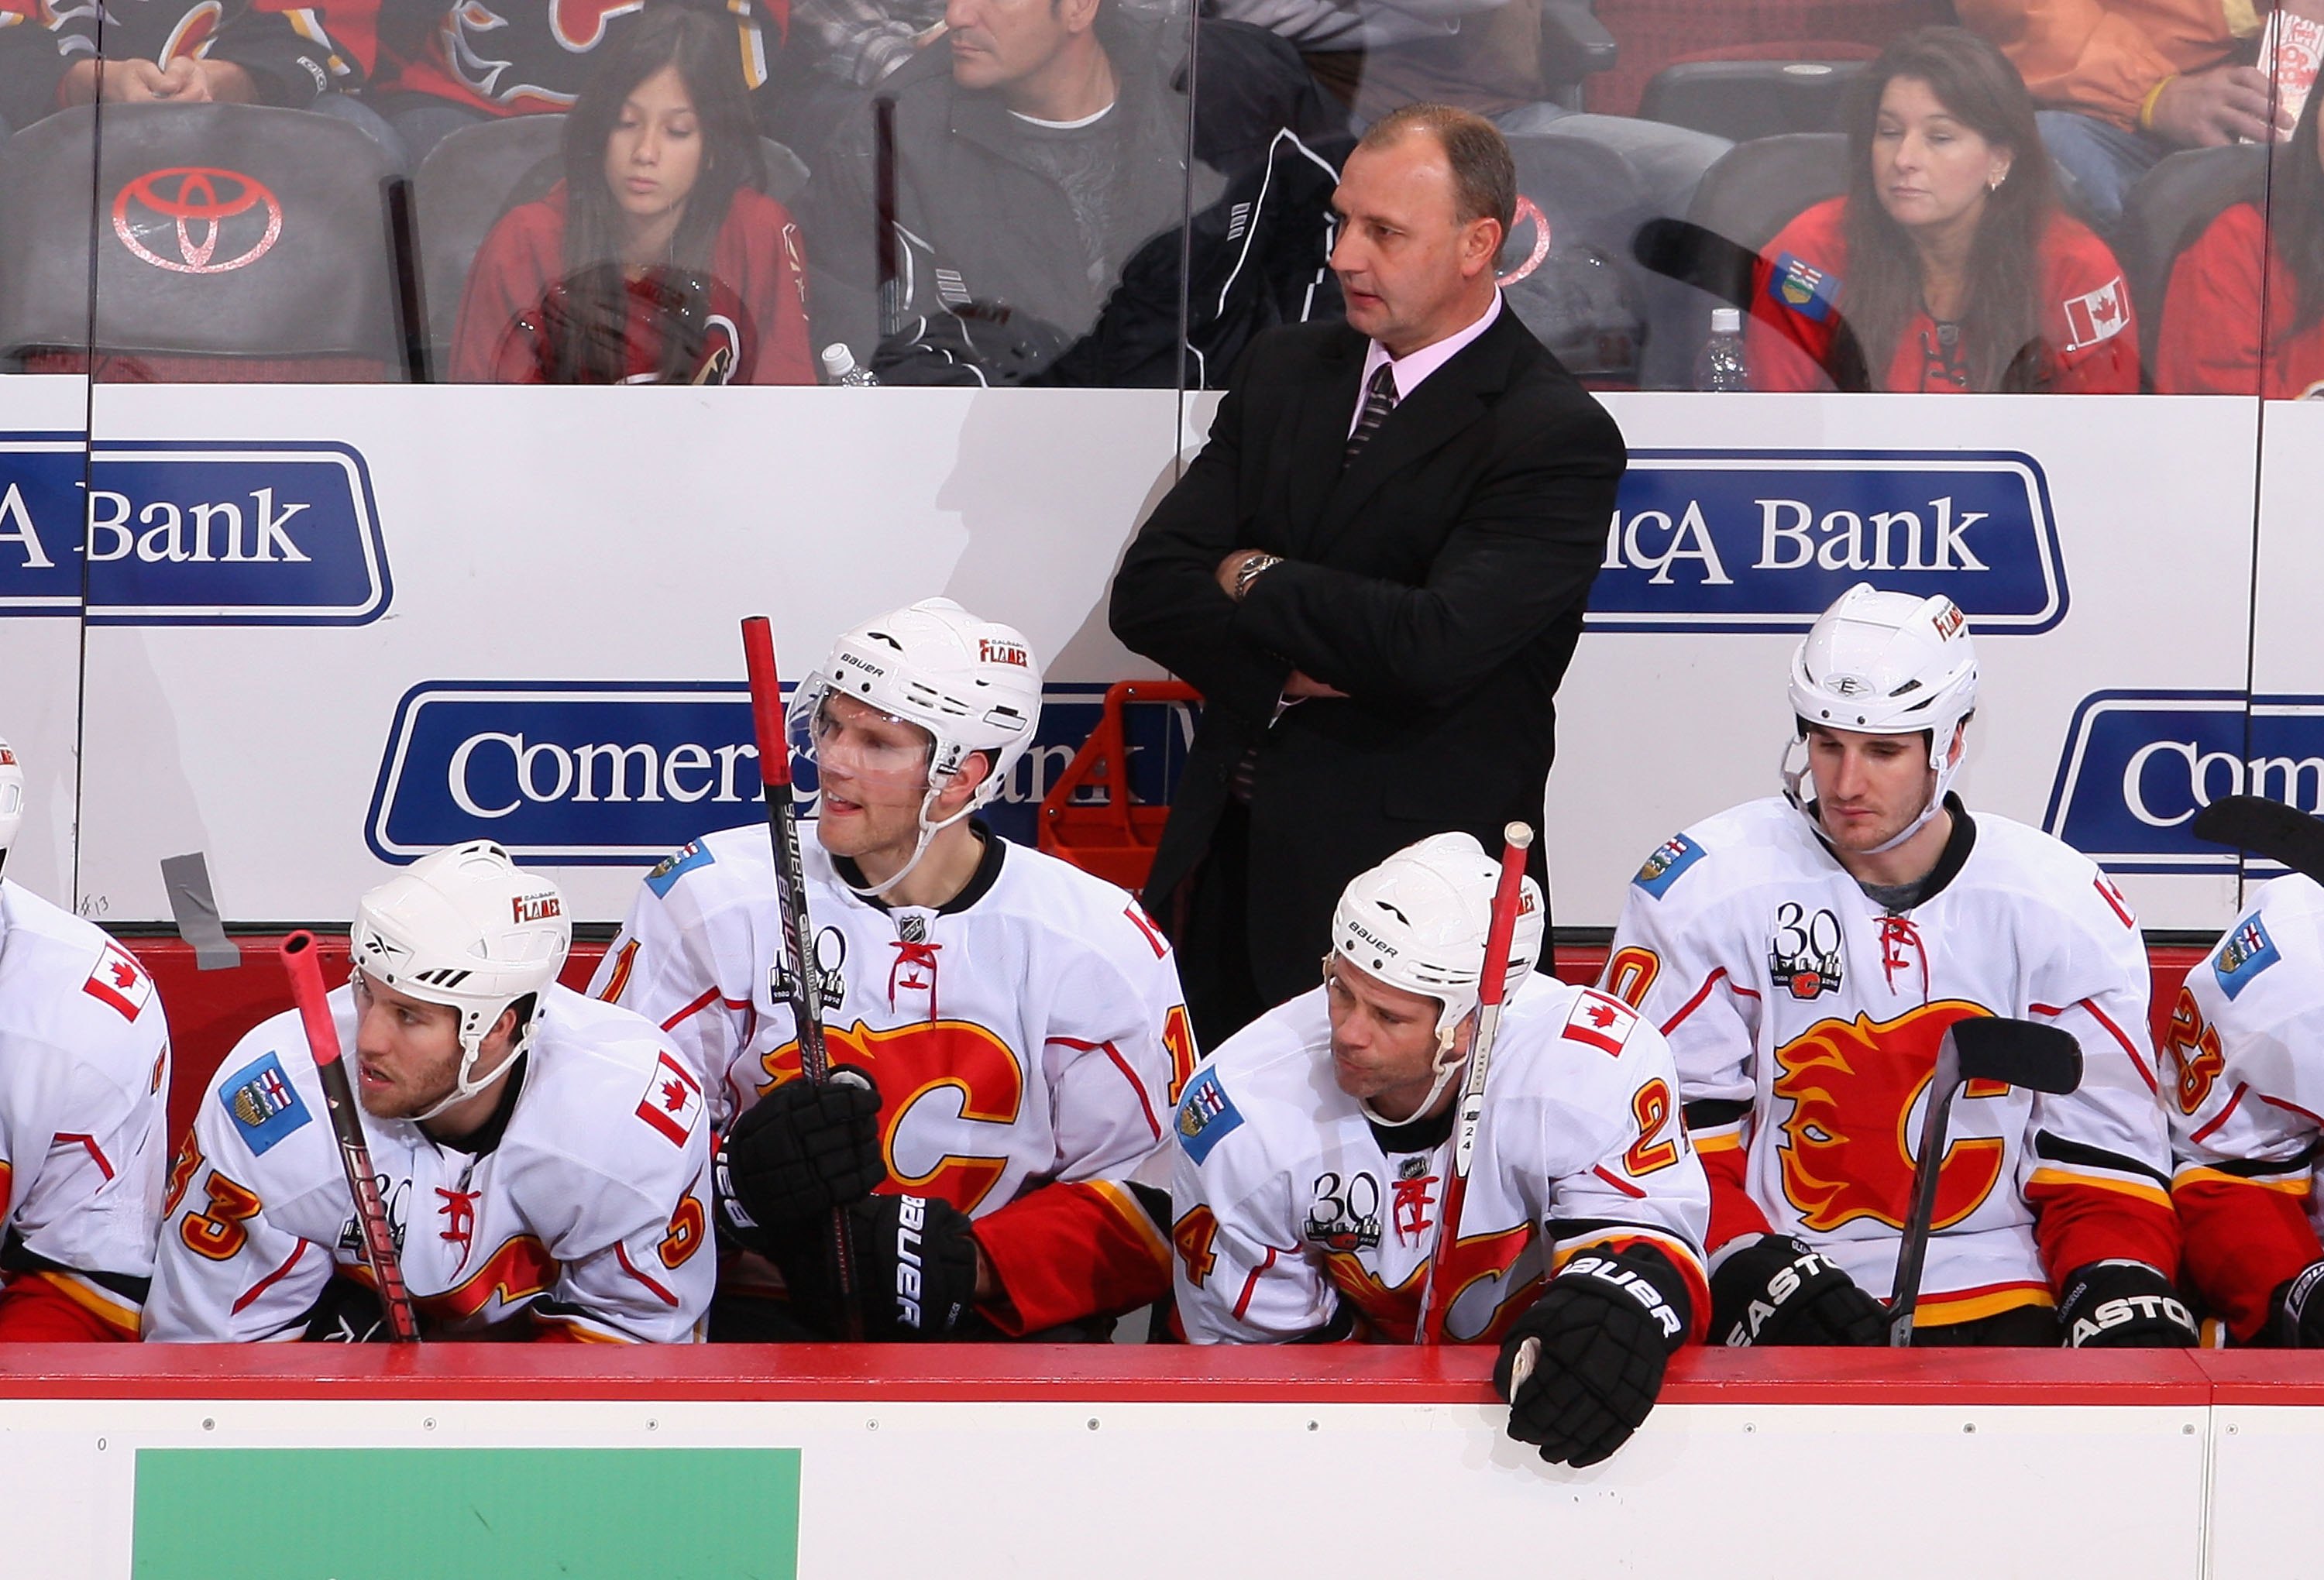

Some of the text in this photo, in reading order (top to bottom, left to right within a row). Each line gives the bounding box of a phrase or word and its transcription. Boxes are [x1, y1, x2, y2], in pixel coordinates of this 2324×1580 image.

[74, 481, 311, 562] Bank
[1752, 496, 1990, 571] Bank
[841, 652, 885, 678] BAUER
[978, 639, 1028, 668] FLAMES
[512, 896, 561, 924] FLAMES
[1773, 902, 1841, 960] 30
[1348, 922, 1397, 957] BAUER
[1310, 1173, 1379, 1224] 30
[896, 1194, 927, 1329] BAUER
